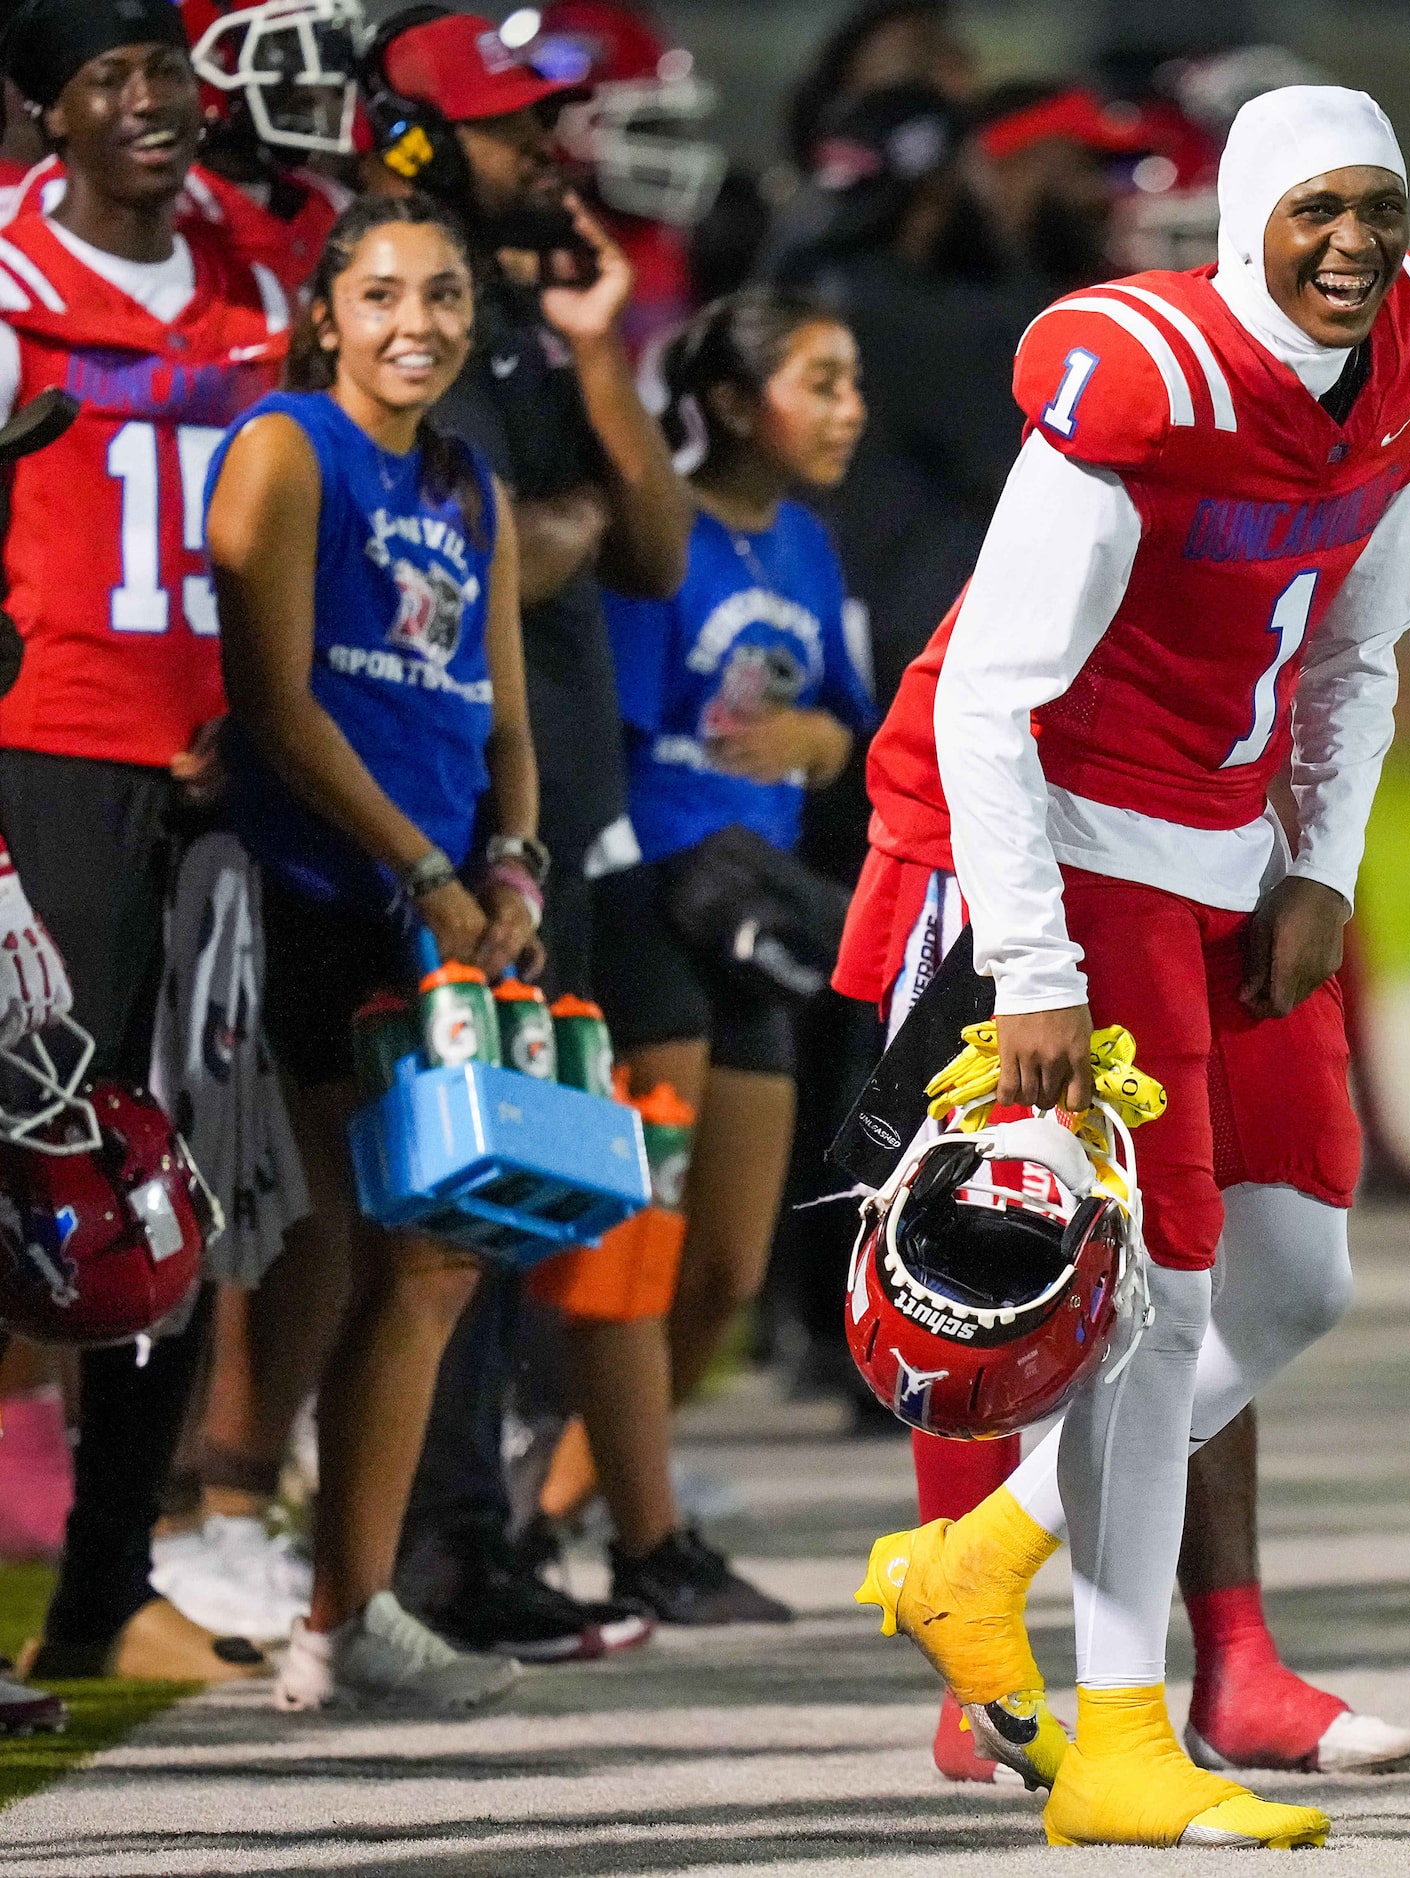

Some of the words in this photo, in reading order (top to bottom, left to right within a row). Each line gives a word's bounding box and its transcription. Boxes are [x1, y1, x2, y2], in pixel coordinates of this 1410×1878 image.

[1041, 346, 1100, 440] 1
[1219, 566, 1321, 769] 1
[859, 1112, 901, 1147] UNLEASHED
[894, 1290, 979, 1340] schutt
